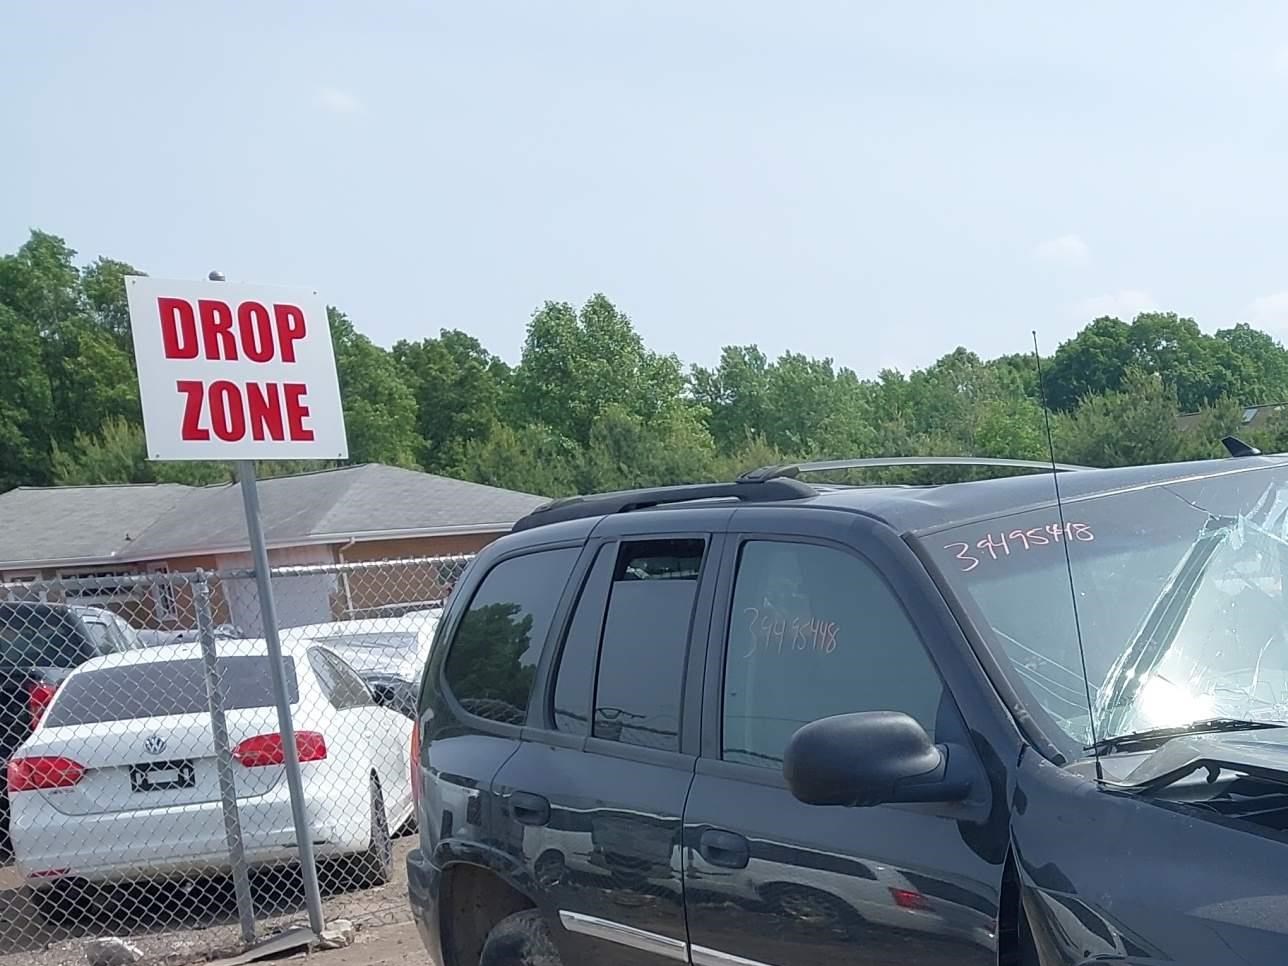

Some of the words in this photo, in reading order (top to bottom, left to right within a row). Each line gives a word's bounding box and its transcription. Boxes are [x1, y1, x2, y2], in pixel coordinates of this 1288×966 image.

[157, 297, 307, 363] DROP
[176, 379, 315, 442] ZONE
[743, 607, 840, 658] 39495448
